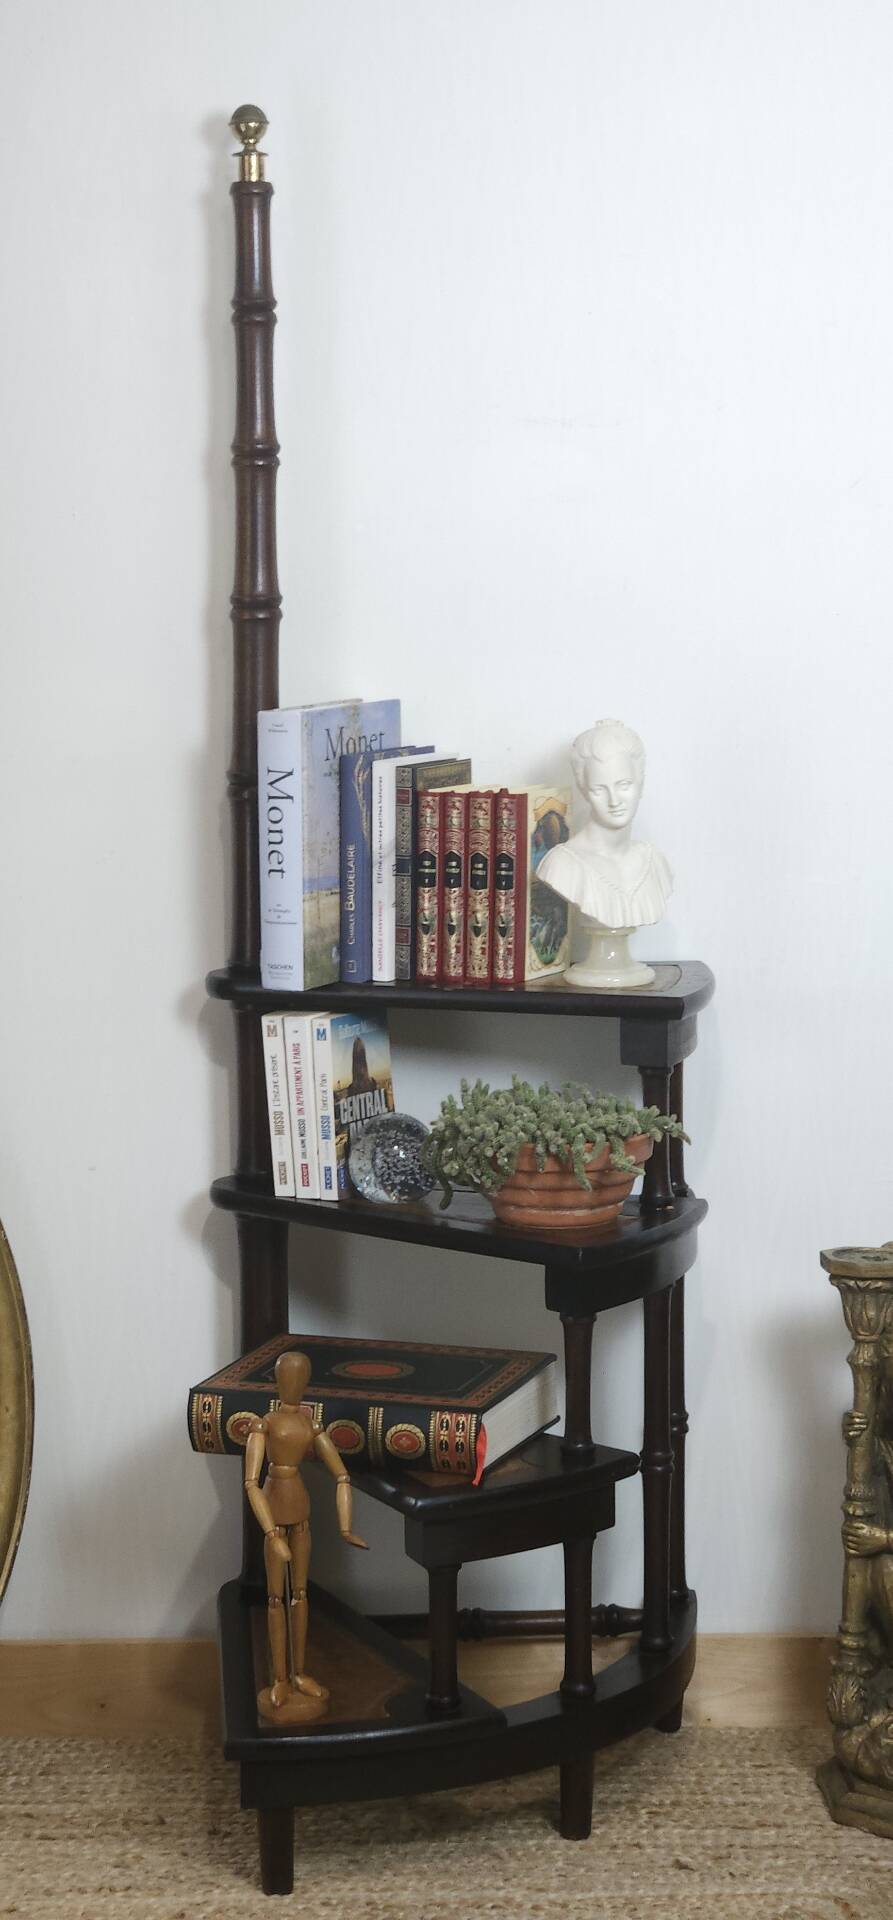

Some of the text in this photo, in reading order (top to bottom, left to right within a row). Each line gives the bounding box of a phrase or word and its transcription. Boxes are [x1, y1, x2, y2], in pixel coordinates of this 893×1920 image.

[324, 726, 386, 762] Monet
[266, 767, 295, 880] Monet
[345, 844, 356, 911] BAUDELAIRE
[292, 1042, 301, 1060] PARIS
[294, 1067, 304, 1106] APPARTEMENT
[295, 1107, 305, 1116] UN
[340, 1088, 388, 1125] CENTRAL
[274, 1111, 285, 1136] MUSSO
[297, 1118, 306, 1138] MUSSO
[320, 1115, 331, 1140] MUSSO
